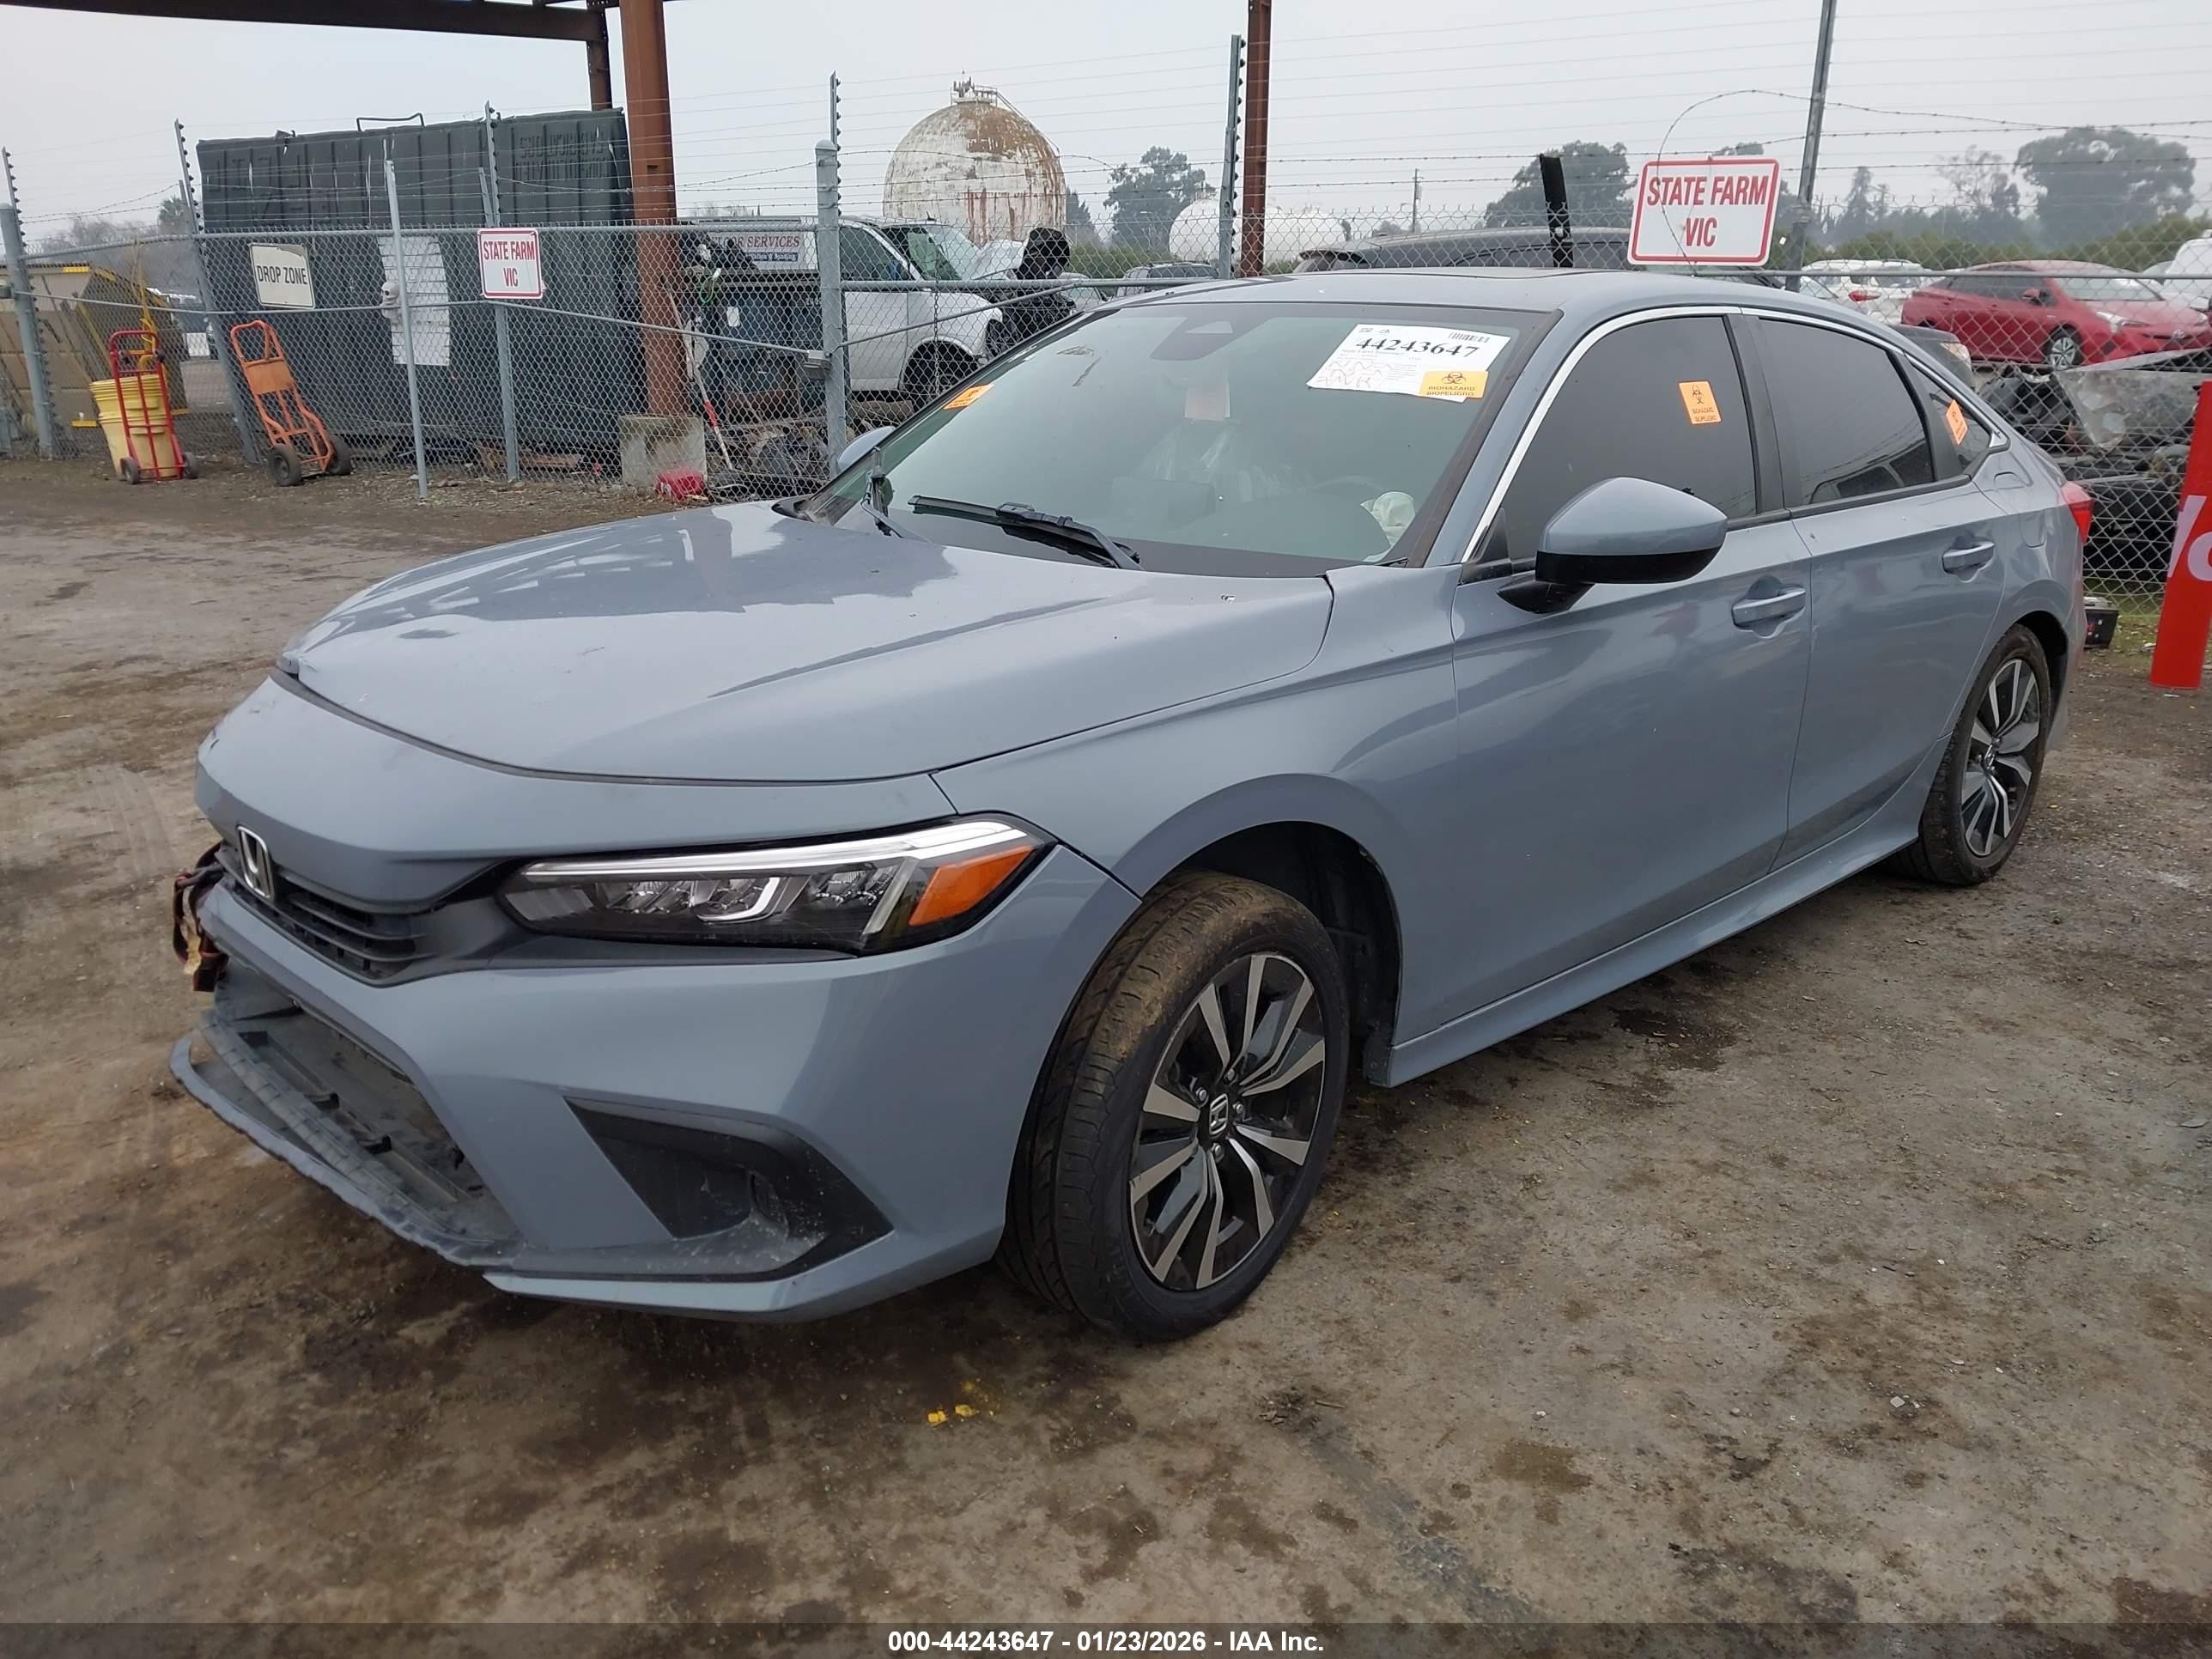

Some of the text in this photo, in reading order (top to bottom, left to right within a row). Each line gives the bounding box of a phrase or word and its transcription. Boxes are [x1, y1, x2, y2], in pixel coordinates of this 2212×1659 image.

[1647, 176, 1769, 206] STATE FARM
[747, 235, 800, 248] SERVICES
[1686, 217, 1717, 247] VIC
[483, 240, 536, 260] STATE FARM
[257, 265, 308, 285] DROP ZONE
[503, 267, 519, 287] VIC
[1356, 337, 1480, 357] 44243647
